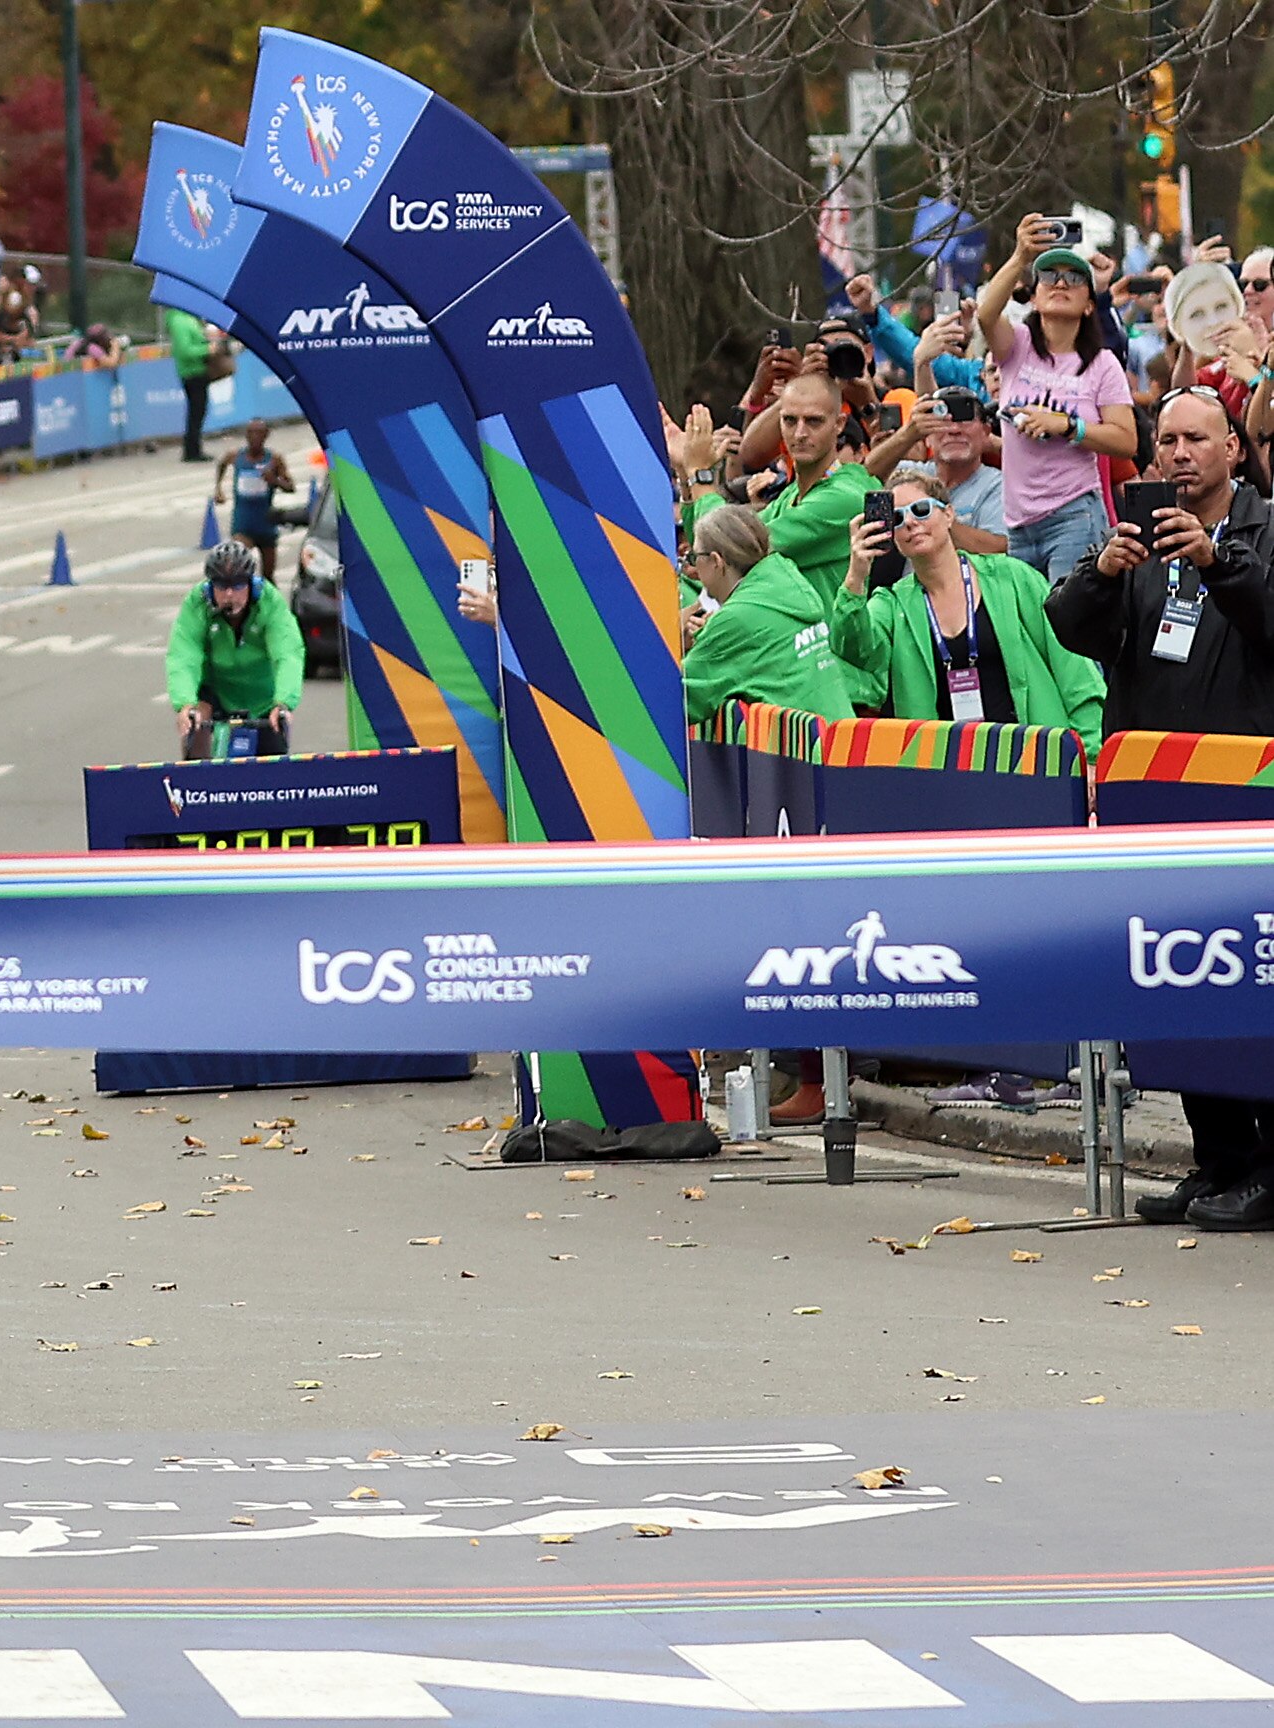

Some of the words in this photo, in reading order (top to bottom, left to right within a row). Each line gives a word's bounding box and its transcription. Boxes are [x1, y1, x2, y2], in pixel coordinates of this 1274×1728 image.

[316, 73, 347, 93] tcs
[351, 91, 381, 127] NEW
[266, 102, 306, 195] MARATHON
[357, 133, 382, 180] YORK
[310, 178, 352, 198] CITY
[456, 193, 493, 205] TATA
[389, 194, 450, 231] tcs
[455, 205, 543, 218] CONSULTANCY
[455, 218, 511, 230] SERVICES
[278, 303, 428, 336] NYRR
[487, 317, 593, 337] NYRR
[278, 341, 304, 351] NEW
[306, 339, 338, 350] YORK
[341, 337, 373, 348] ROAD
[376, 334, 431, 346] RUNNERS
[487, 339, 506, 347] NEW
[508, 339, 530, 347] YORK
[532, 339, 554, 347] ROAD
[556, 339, 594, 347] RUNNERS
[186, 789, 207, 803] tcs
[209, 791, 238, 802] NEW
[241, 789, 274, 801] YORK
[277, 787, 305, 799] CITY
[308, 784, 378, 798] MARATHON
[423, 934, 497, 955] TATA
[1128, 916, 1245, 988] tcs
[298, 938, 416, 1004] tcs
[424, 955, 592, 979] CONSULTANCY
[746, 944, 978, 987] NYRR
[35, 978, 95, 995] YORK
[97, 977, 149, 994] CITY
[425, 980, 533, 1002] SERVICES
[745, 993, 788, 1011] NEW
[790, 993, 839, 1010] YORK
[842, 993, 891, 1010] ROAD
[895, 992, 979, 1009] RUNNERS
[233, 1495, 598, 1512] YORK
[641, 1485, 949, 1504] NEW
